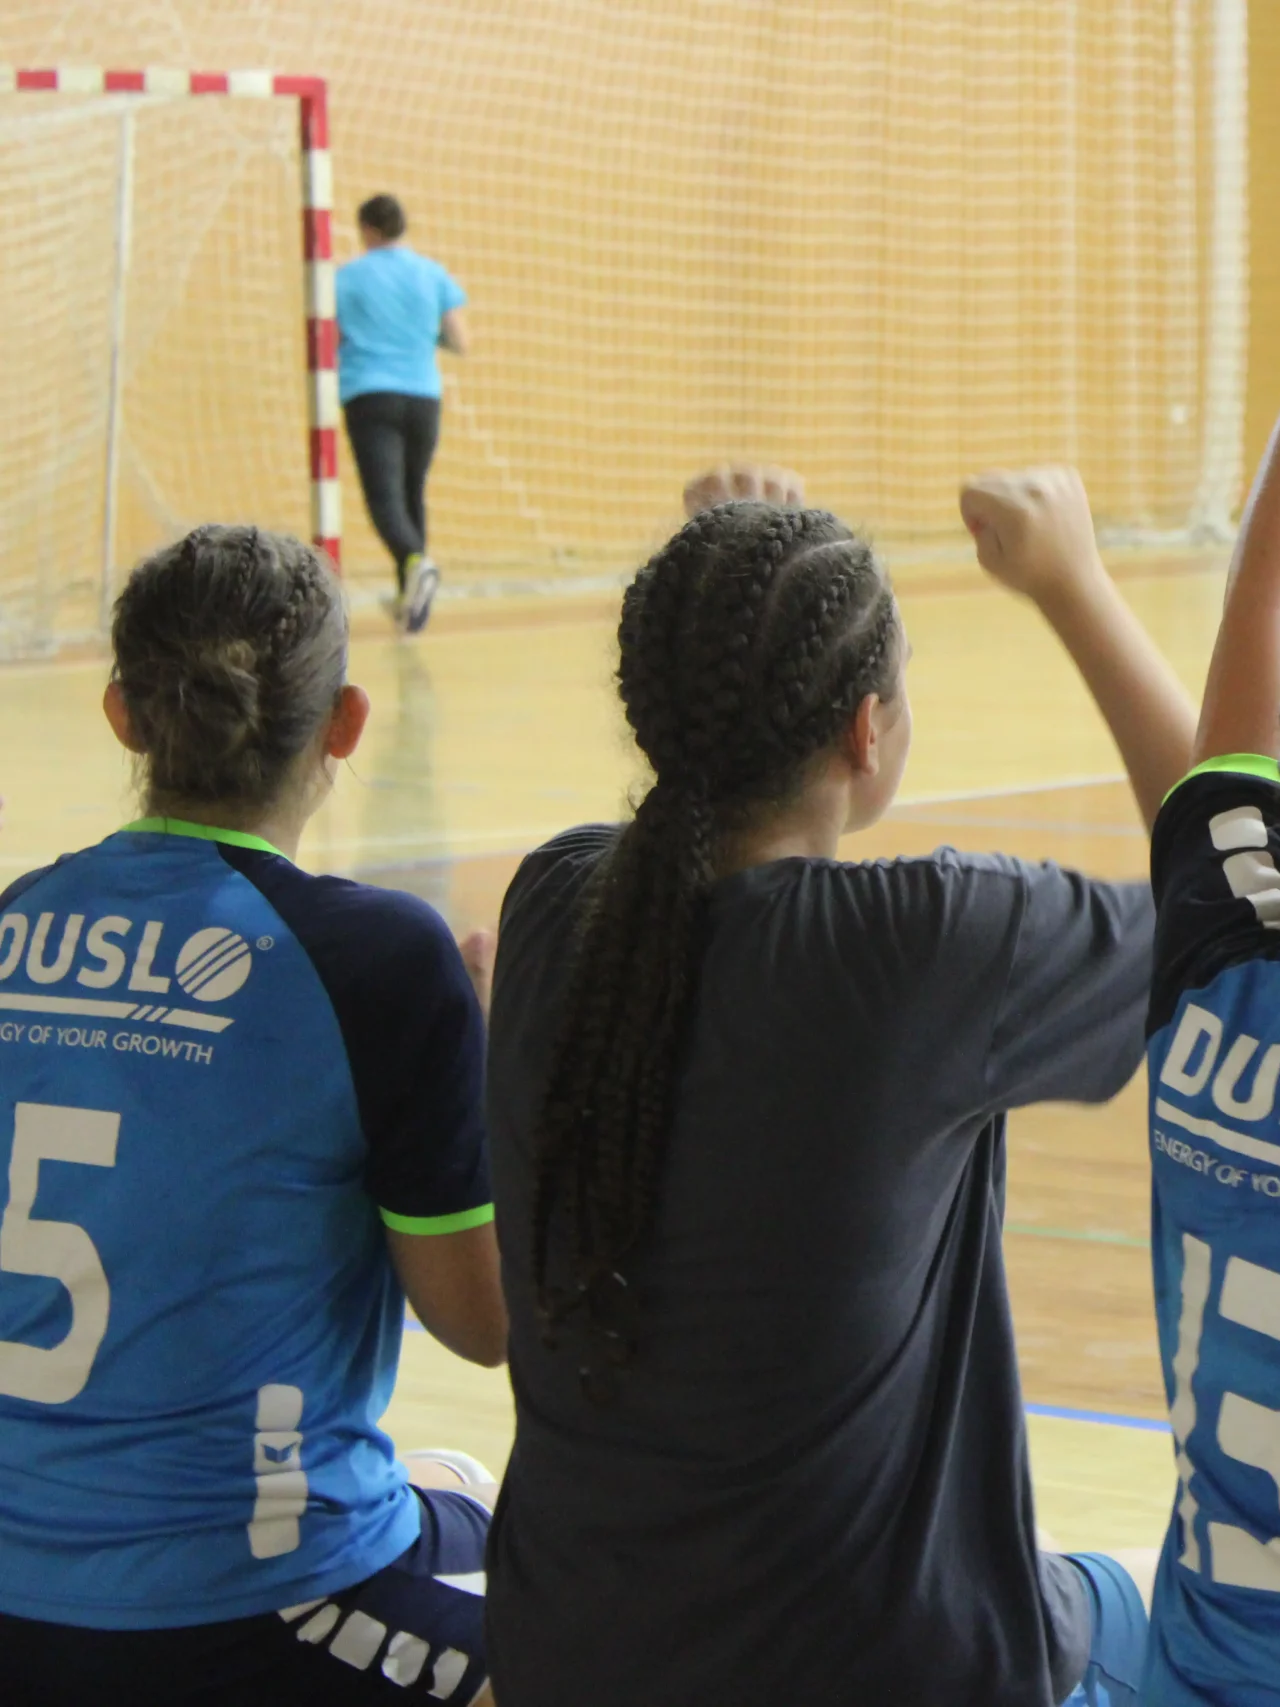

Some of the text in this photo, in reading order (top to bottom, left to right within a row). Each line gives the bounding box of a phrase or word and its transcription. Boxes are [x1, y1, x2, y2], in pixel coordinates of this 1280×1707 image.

[28, 1024, 53, 1045] OF
[57, 1027, 107, 1050] YOUR
[112, 1031, 214, 1065] GROWTH
[1152, 1128, 1218, 1176] ENERGY
[1214, 1164, 1249, 1188] OF
[0, 1101, 121, 1405] 5
